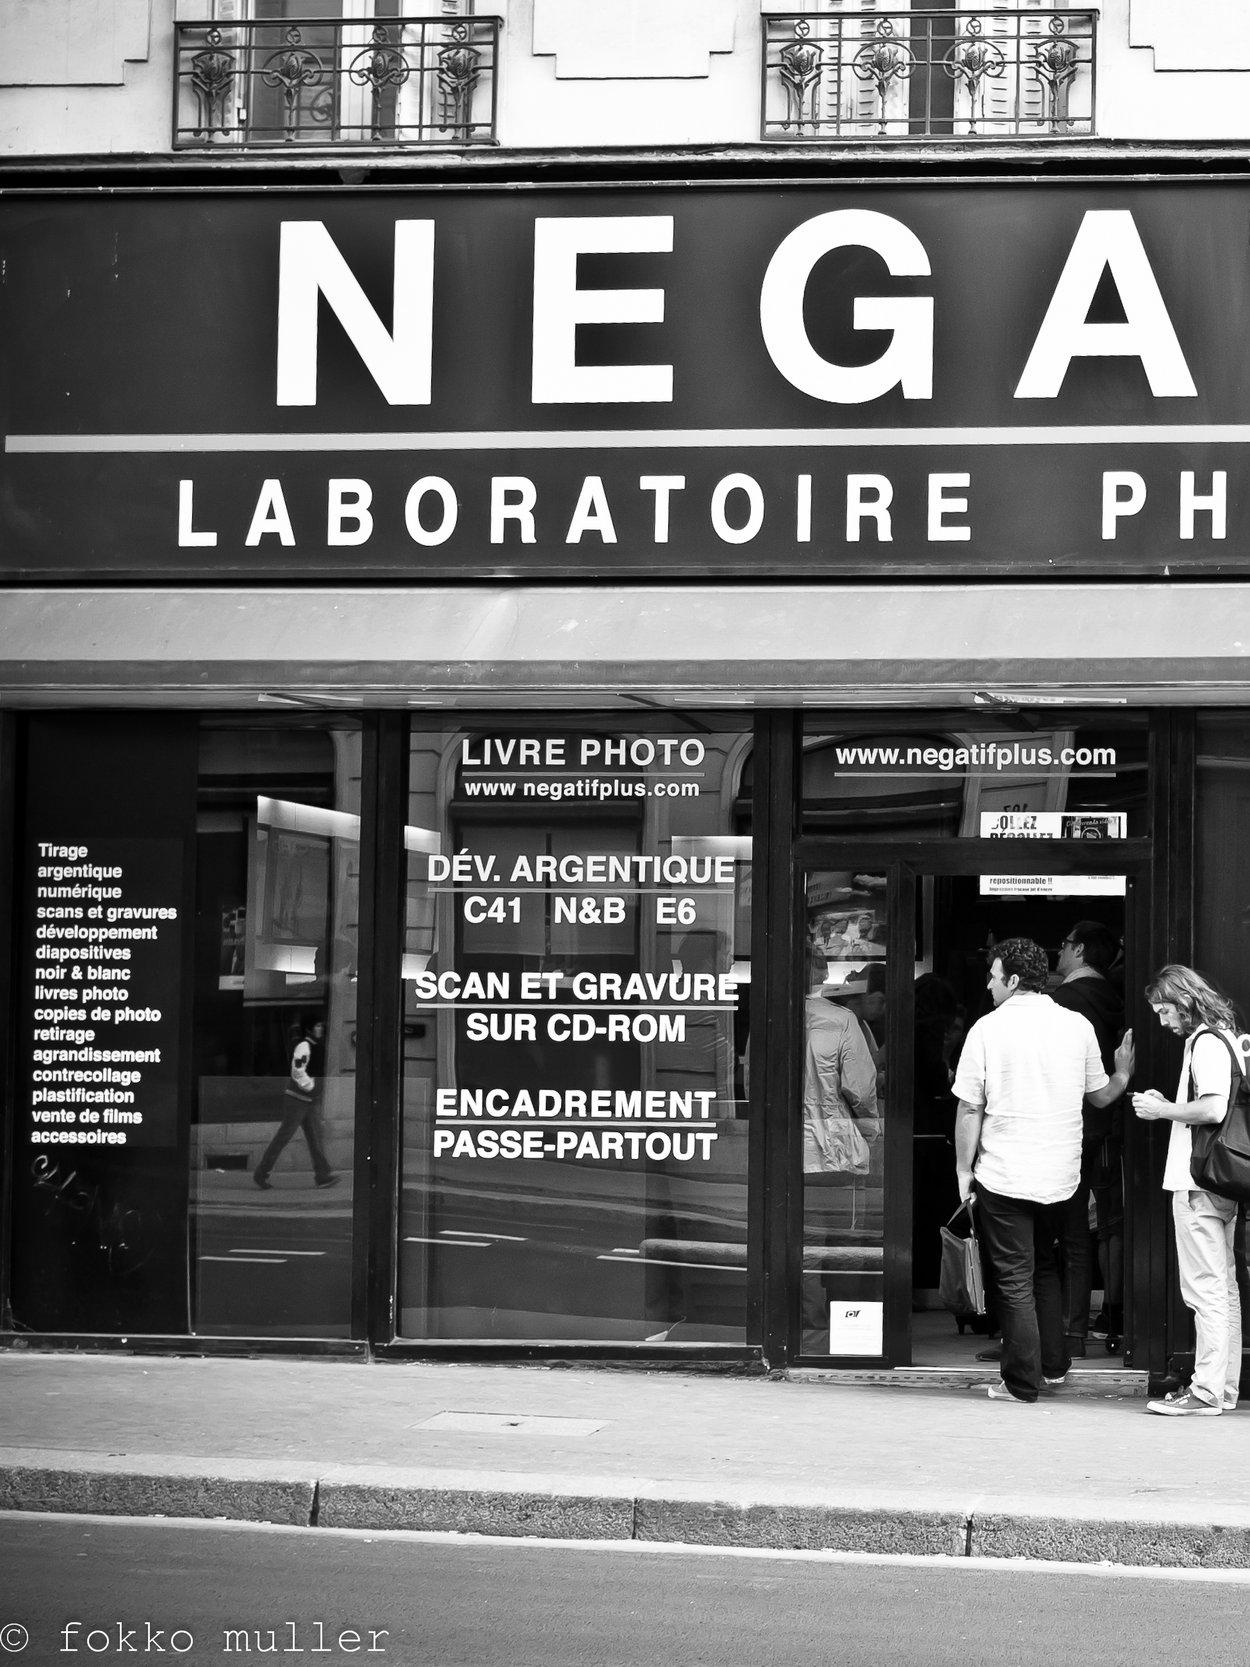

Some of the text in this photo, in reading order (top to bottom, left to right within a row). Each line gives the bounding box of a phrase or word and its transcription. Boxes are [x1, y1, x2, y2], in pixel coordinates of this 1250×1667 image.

[177, 472, 972, 548] LABORATOIRE
[462, 738, 705, 766] LIVRE PHOTO
[835, 743, 1116, 770] www.negatifplus.com
[464, 778, 700, 801] www negatifplus.com
[38, 842, 88, 861] Tirage
[37, 863, 122, 882] argentique
[428, 849, 736, 884] DÉV. ARGENTIQUE
[37, 883, 122, 902] numérique
[36, 904, 177, 923] scans et gravures
[463, 896, 697, 925] C41 N&B E6
[36, 923, 157, 943] développement
[35, 944, 131, 963] diapositives
[35, 964, 130, 981] noir & blanc
[34, 985, 128, 1004] livres photo
[414, 972, 740, 1001] SCAN ET GRAVURE
[34, 1005, 161, 1025] copies de photo
[33, 1026, 95, 1045] retirage
[466, 1012, 686, 1043] SUR CD-ROM
[32, 1046, 160, 1065] agrandissement
[32, 1067, 141, 1087] contrecollage
[32, 1087, 134, 1106] plastification
[436, 1088, 717, 1119] ENCADREMENT
[31, 1108, 142, 1125] vente de films
[30, 1128, 126, 1145] accessoires
[433, 1129, 718, 1161] PASSE-PARTOUT
